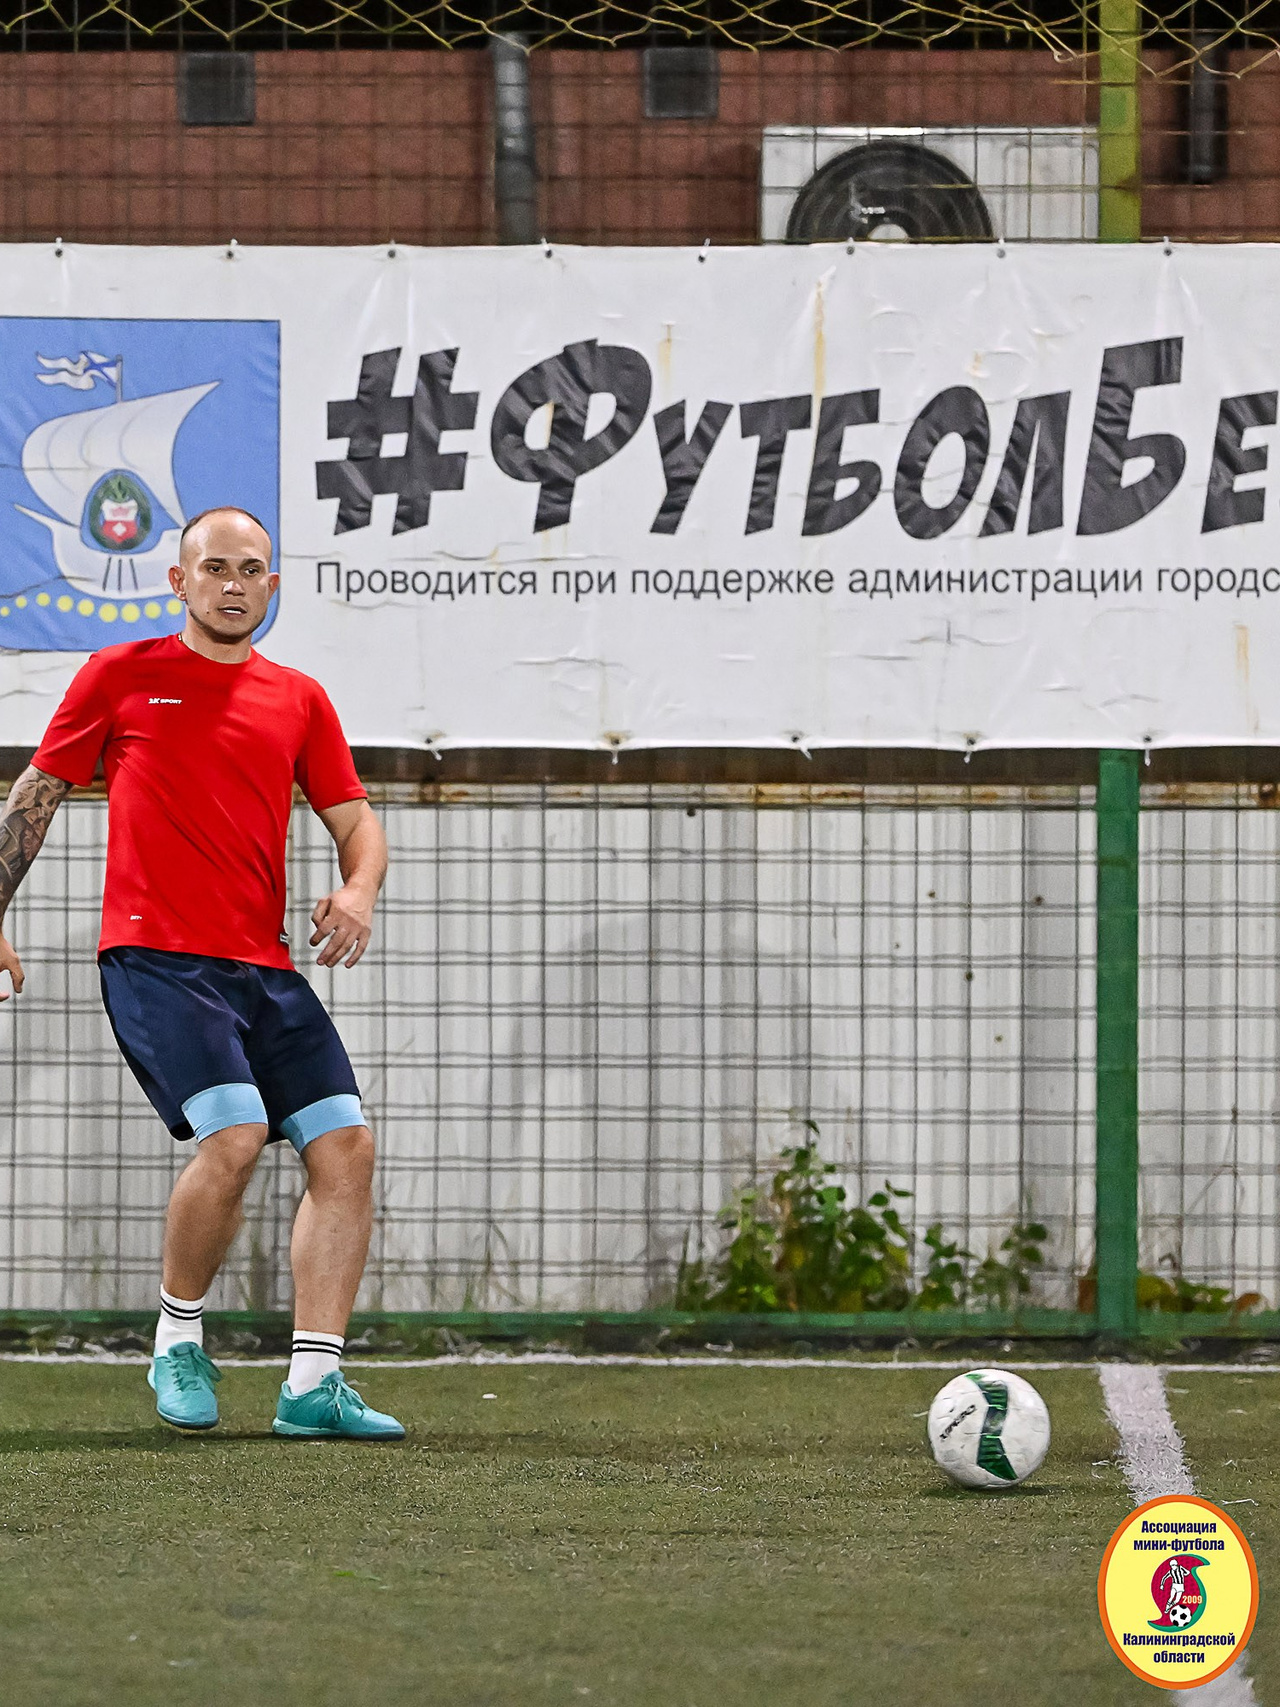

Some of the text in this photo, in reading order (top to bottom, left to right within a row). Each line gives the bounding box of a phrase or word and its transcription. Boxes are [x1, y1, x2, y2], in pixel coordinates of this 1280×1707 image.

[316, 562, 537, 602] Проводится
[552, 569, 616, 602] при
[631, 569, 833, 602] поддержке
[848, 567, 1142, 601] администрации
